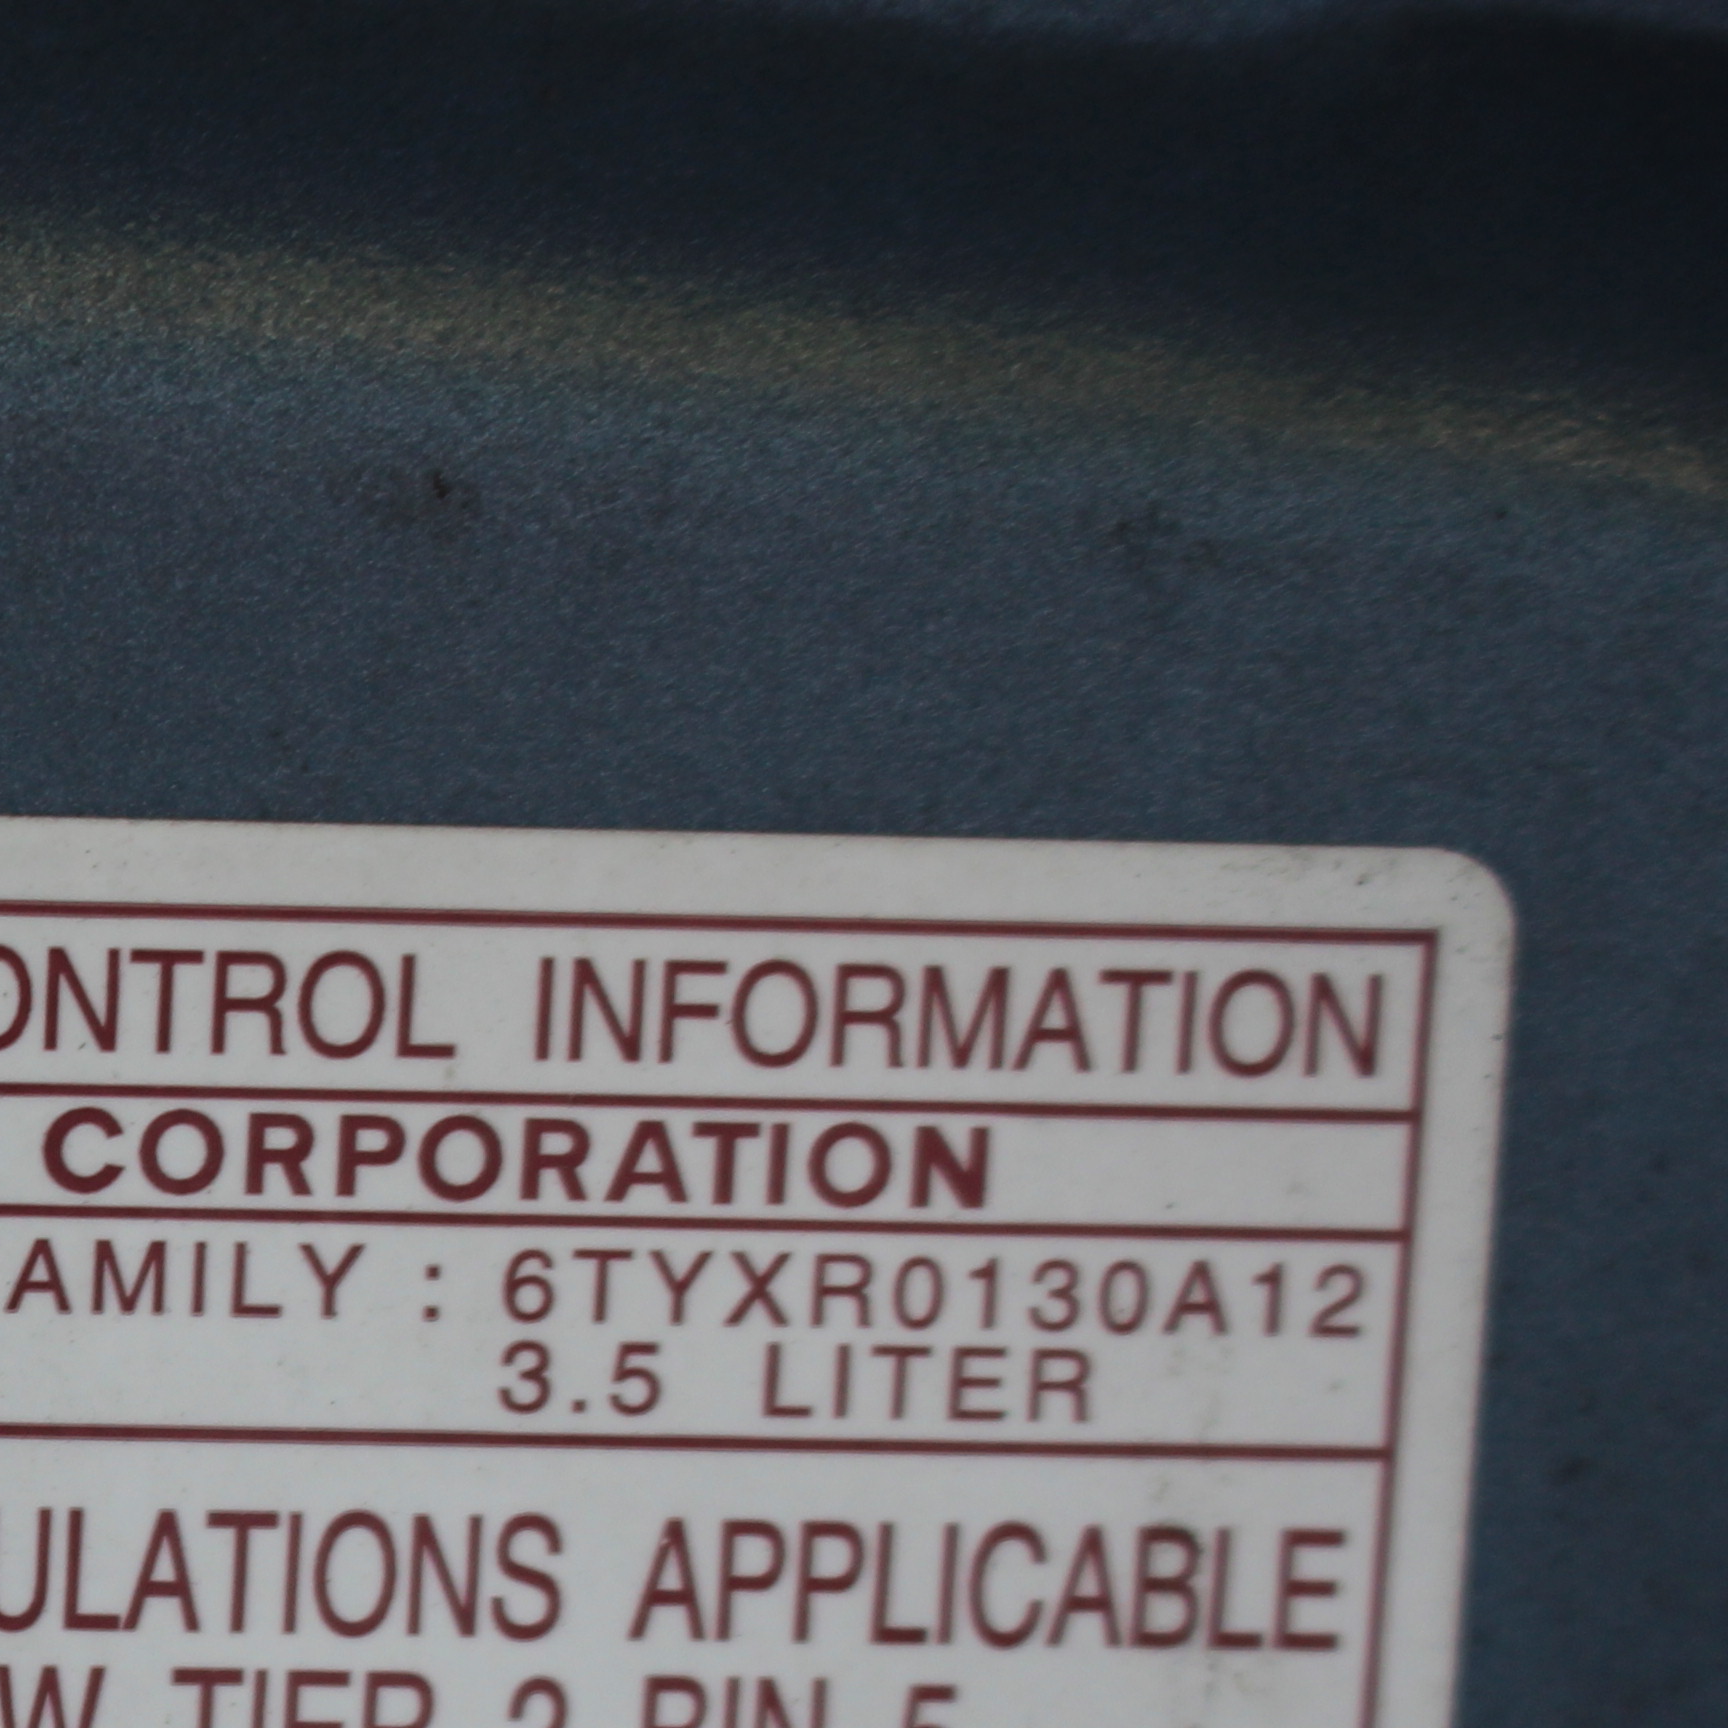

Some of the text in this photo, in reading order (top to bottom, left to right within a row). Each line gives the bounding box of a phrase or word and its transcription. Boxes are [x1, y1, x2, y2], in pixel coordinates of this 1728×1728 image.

[535, 957, 1383, 1078] INFORMATION
[42, 1106, 990, 1209] CORPORATION
[503, 1249, 1363, 1338] 6TYXR0130A12
[499, 1340, 1091, 1421] 3.5 LITER
[629, 1518, 1346, 1652] APPLICABLE
